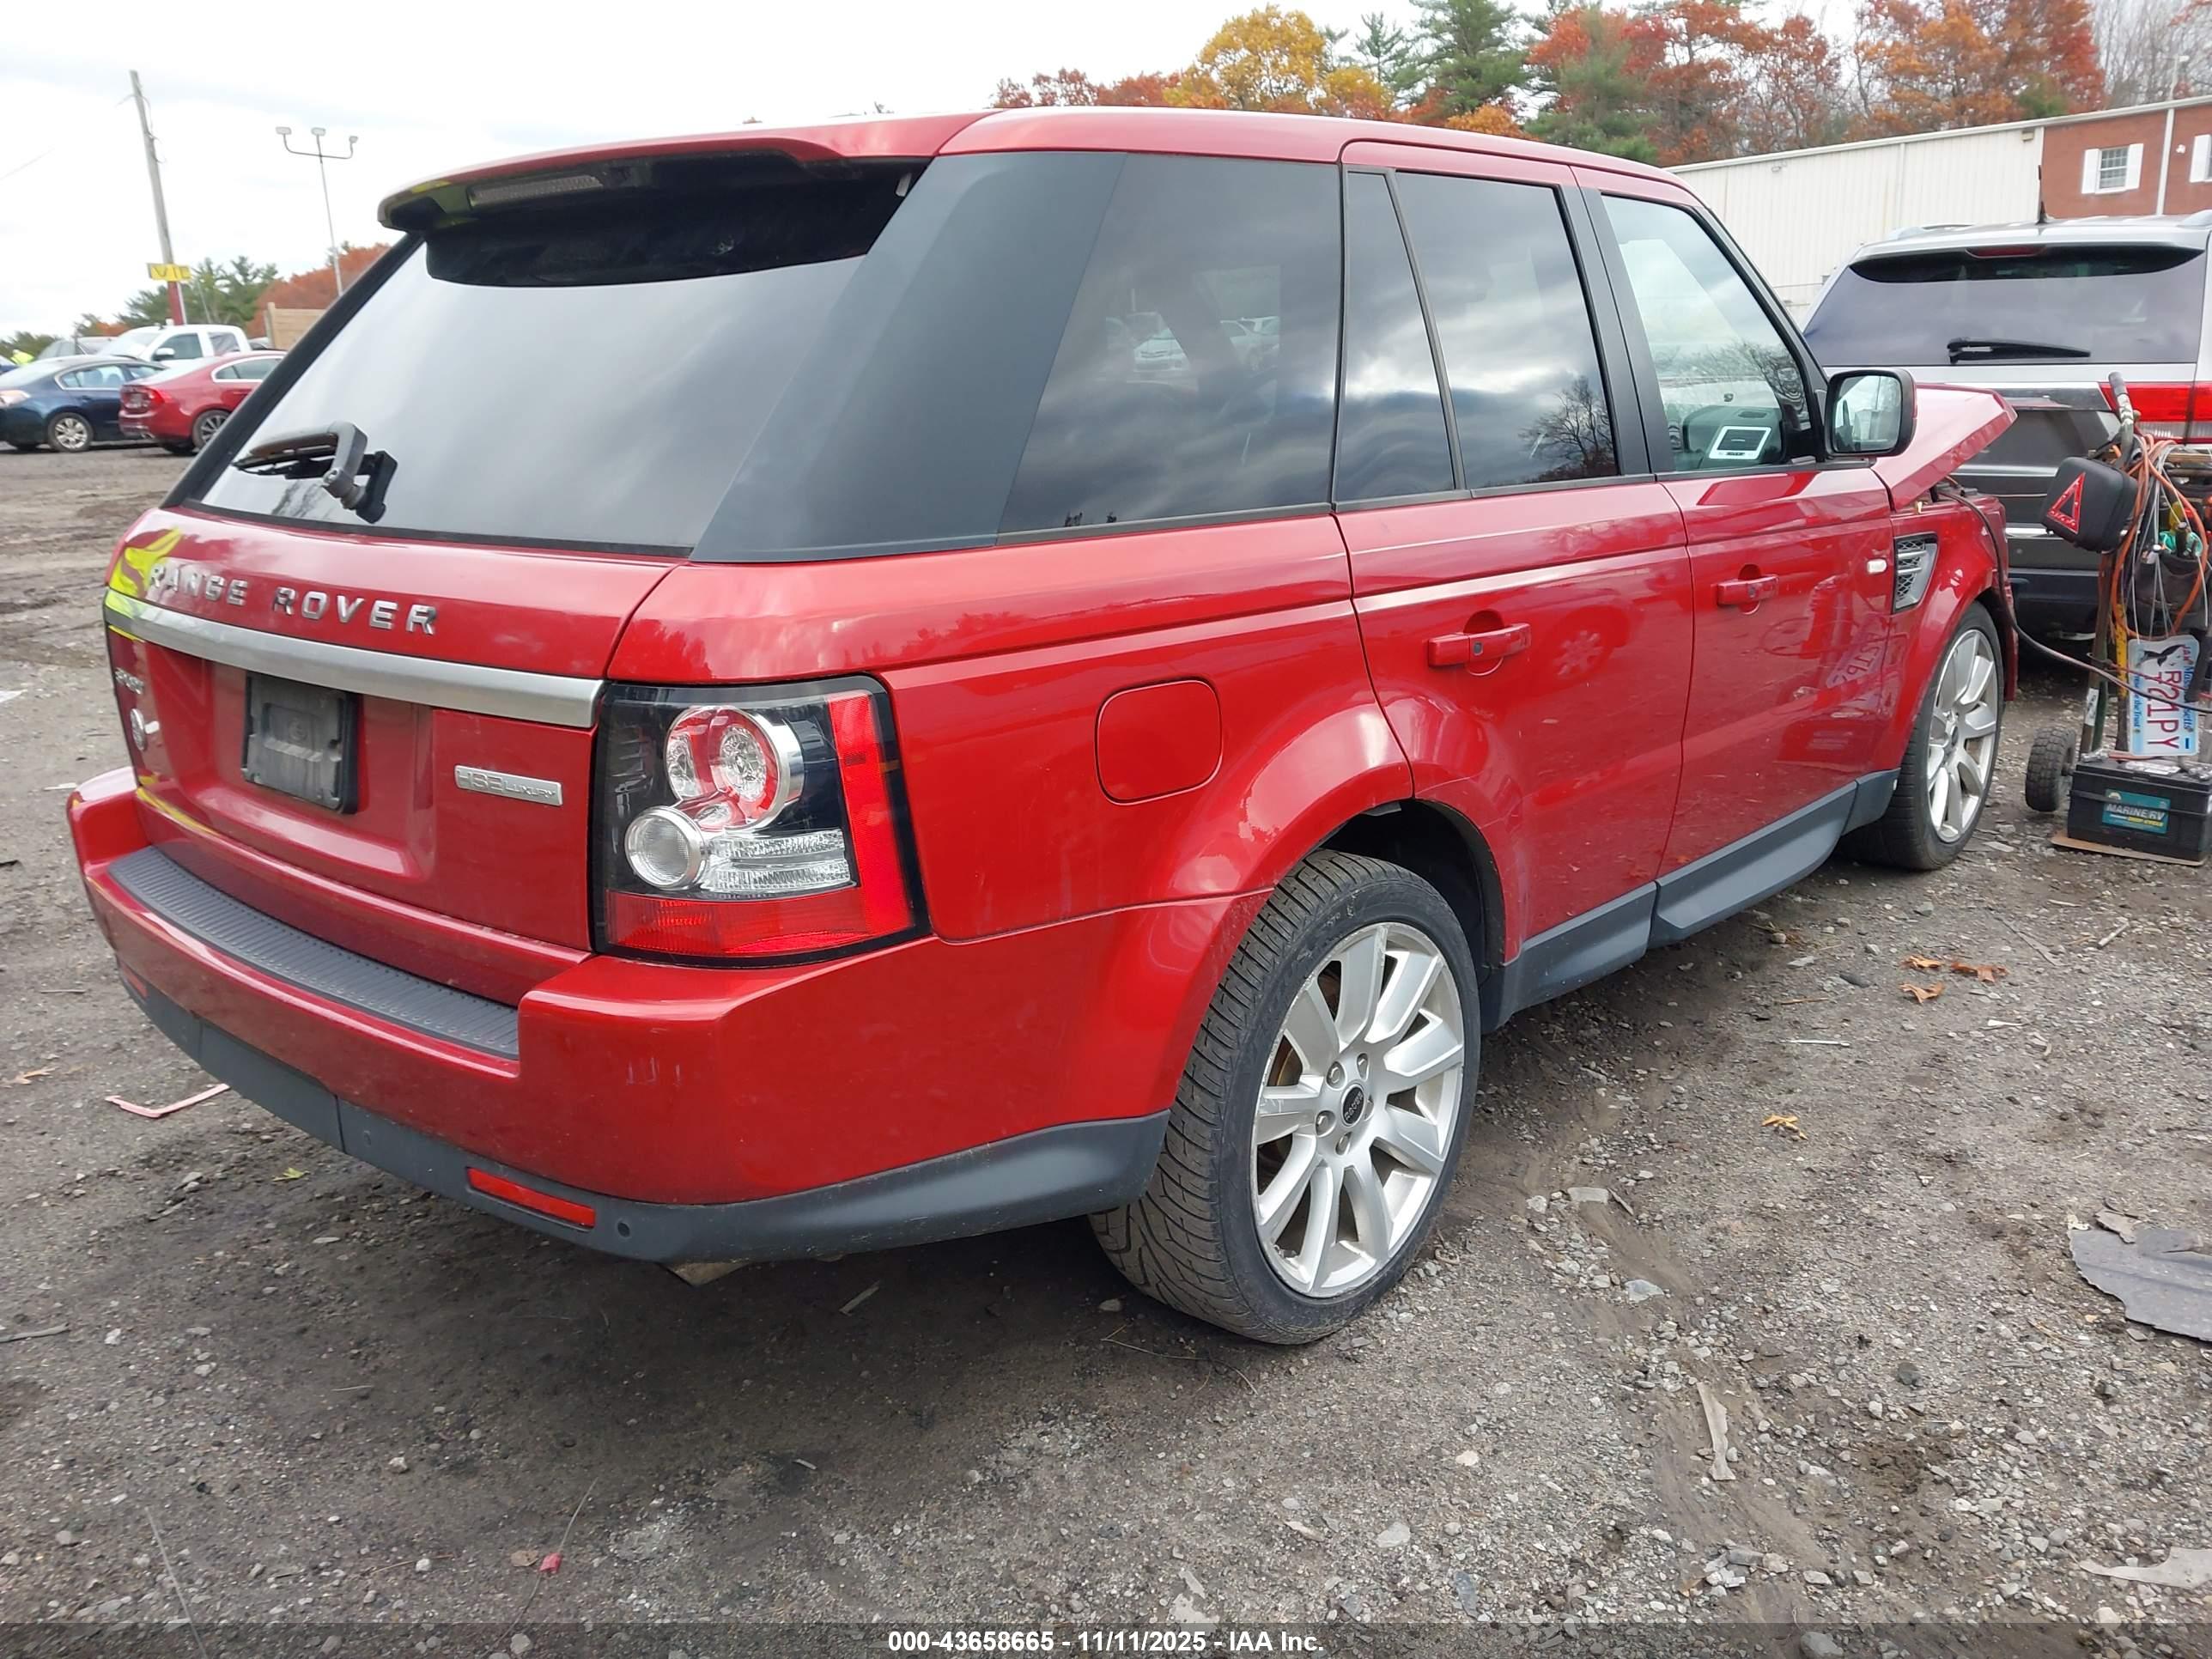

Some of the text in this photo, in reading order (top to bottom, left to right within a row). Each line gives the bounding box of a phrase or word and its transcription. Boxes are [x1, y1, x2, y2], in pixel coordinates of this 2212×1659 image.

[149, 562, 438, 636] RANGE ROVER
[456, 769, 503, 793] HSE
[2106, 803, 2147, 818] MARINE
[2148, 809, 2166, 821] RV
